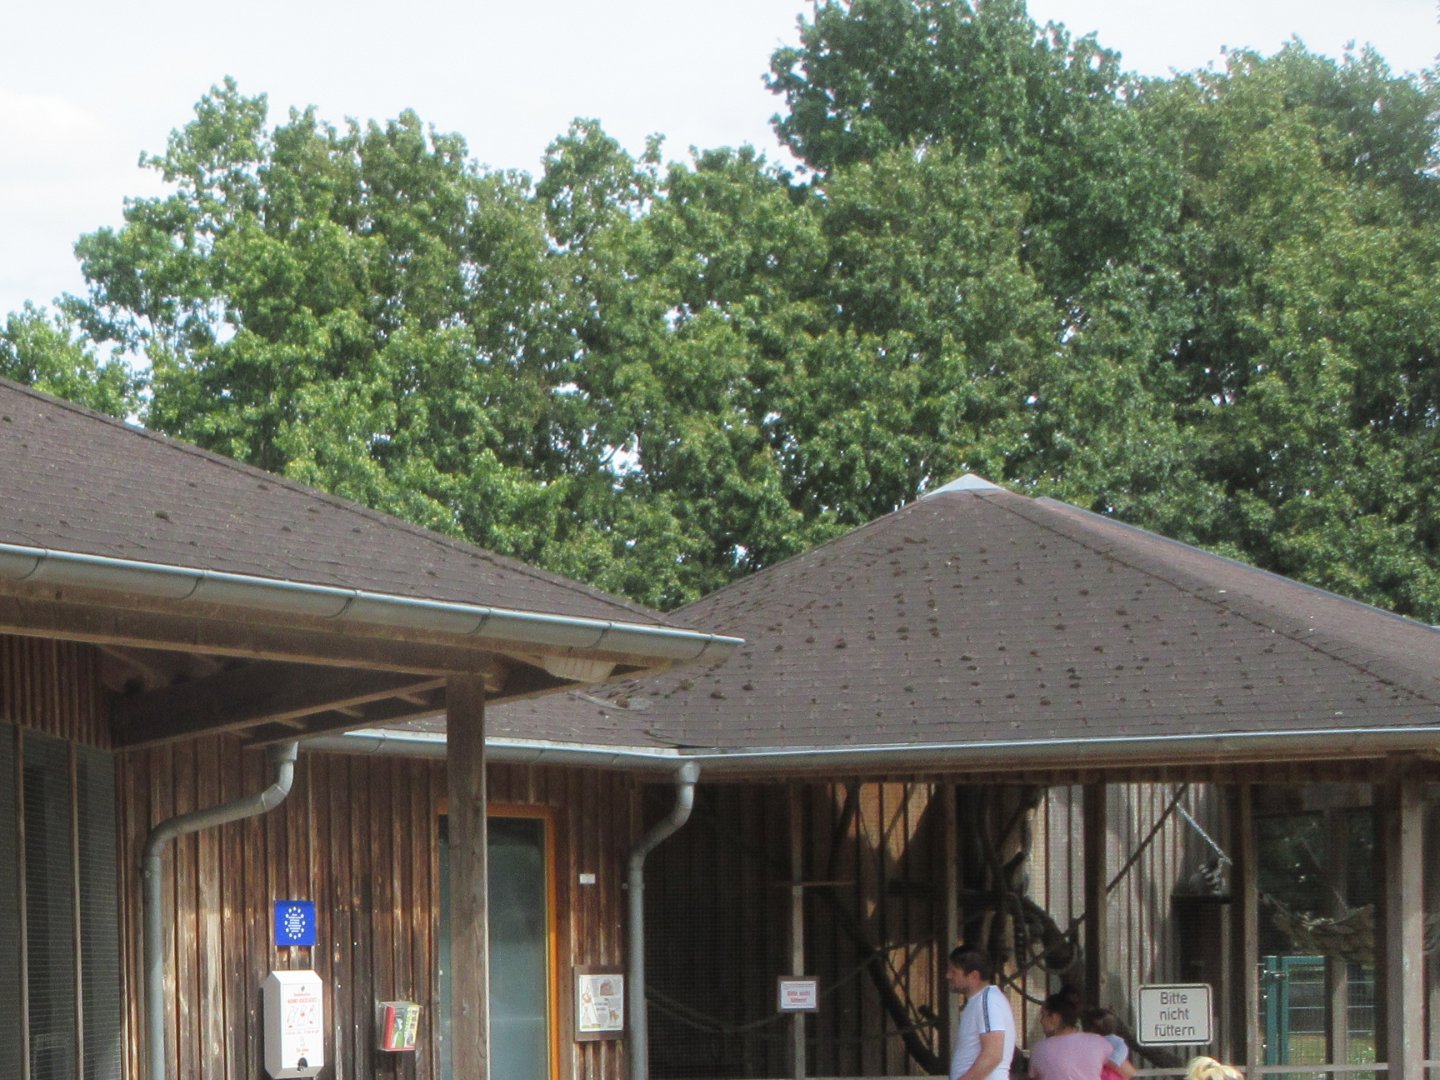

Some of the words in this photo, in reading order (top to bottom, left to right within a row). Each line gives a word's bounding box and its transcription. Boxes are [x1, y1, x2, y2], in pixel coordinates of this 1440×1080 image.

[1160, 992, 1188, 1005] Bitte
[1160, 1008, 1189, 1021] nicht
[1154, 1024, 1195, 1037] füttern
